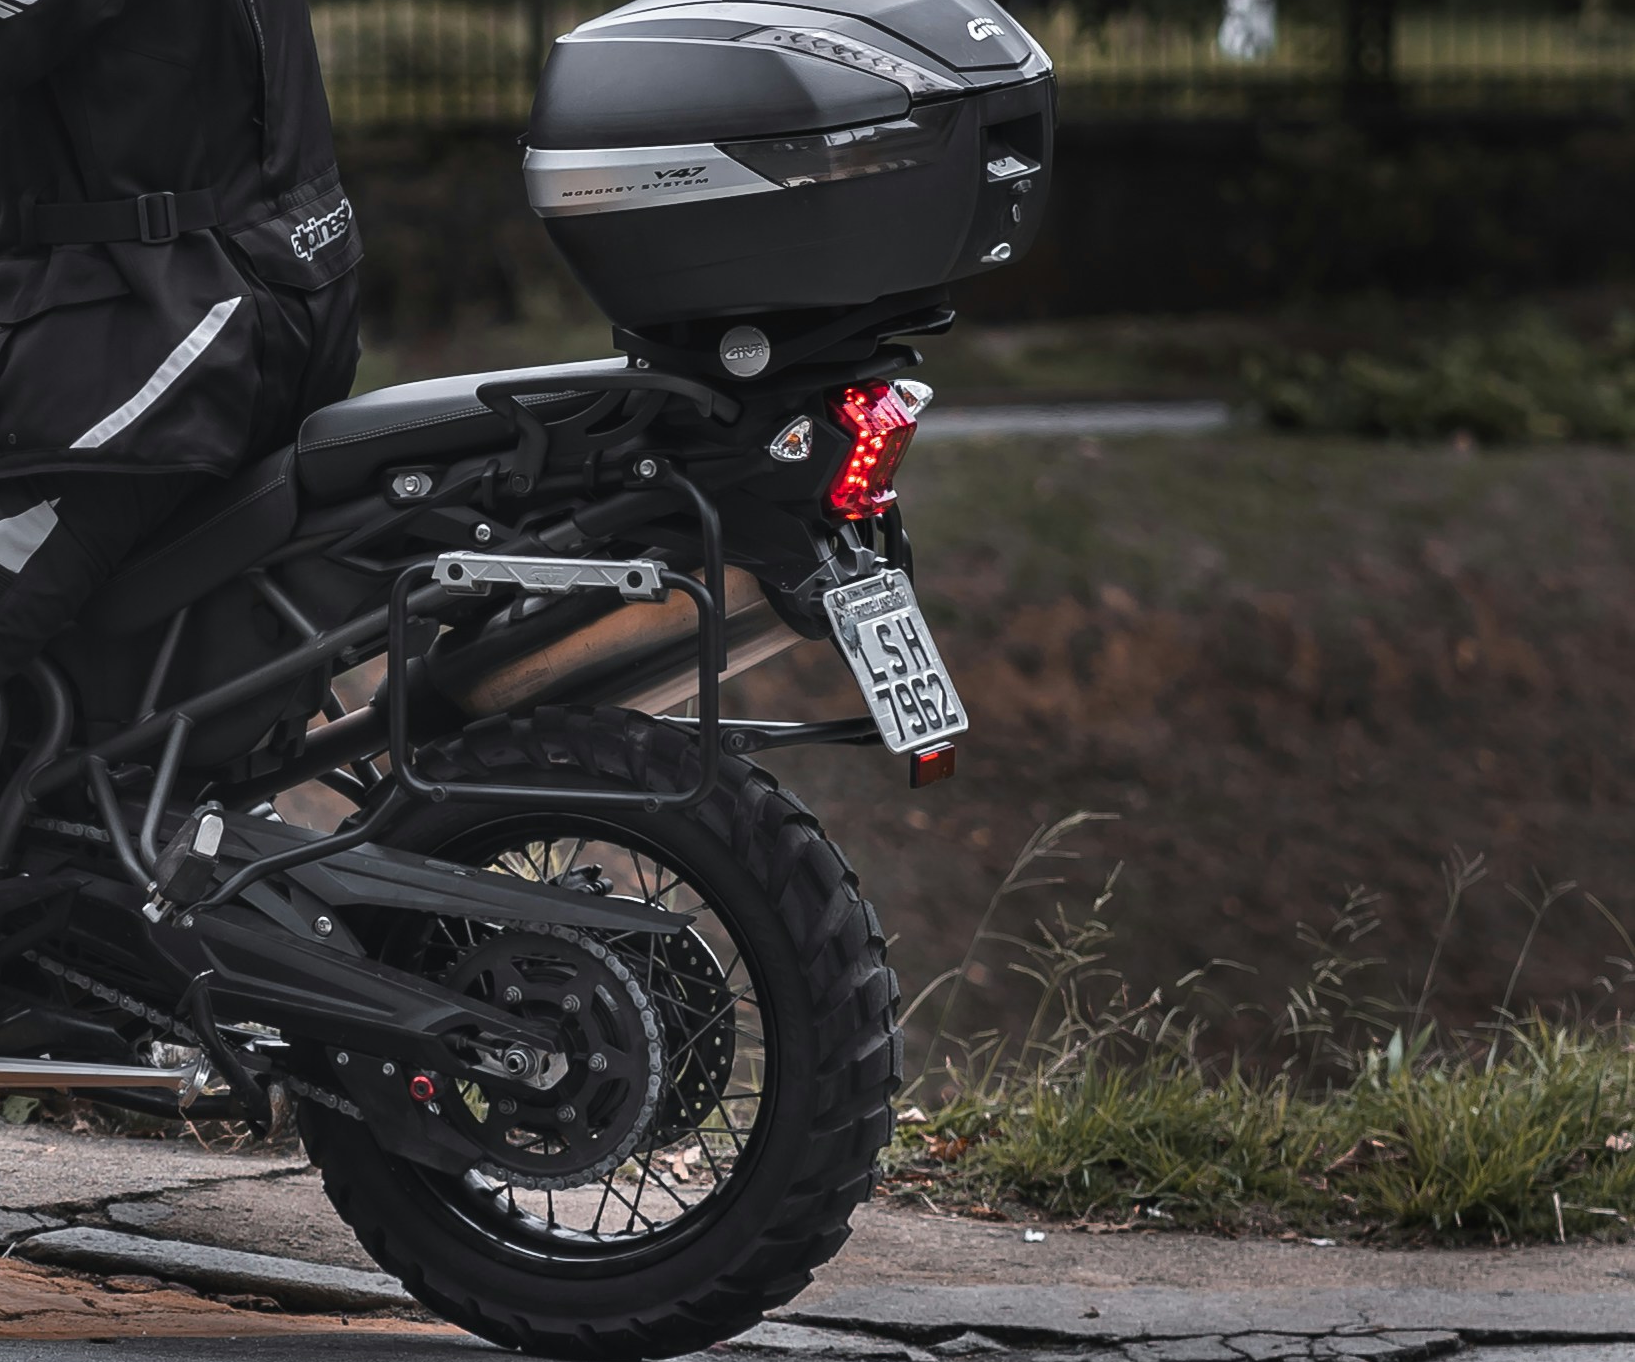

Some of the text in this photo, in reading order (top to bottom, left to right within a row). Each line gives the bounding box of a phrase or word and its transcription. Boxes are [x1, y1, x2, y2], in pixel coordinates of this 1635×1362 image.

[561, 178, 709, 198] MONOKEY SYSTEM
[653, 166, 707, 180] V47
[857, 613, 932, 683] LSH
[871, 670, 959, 742] 7962
